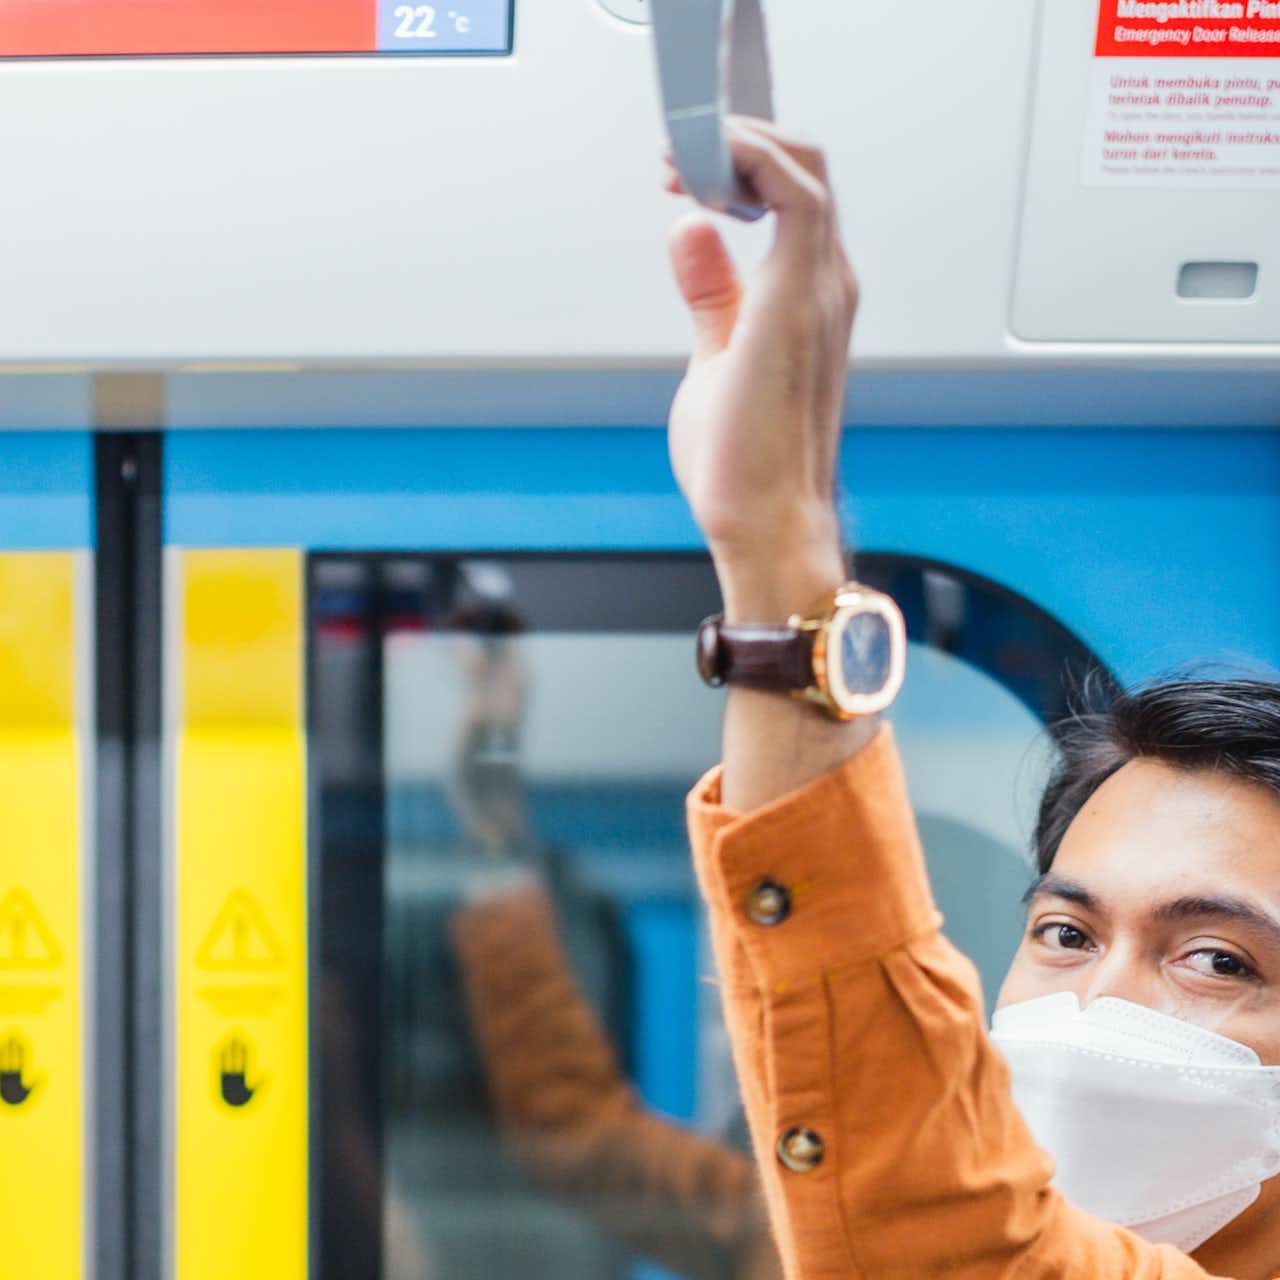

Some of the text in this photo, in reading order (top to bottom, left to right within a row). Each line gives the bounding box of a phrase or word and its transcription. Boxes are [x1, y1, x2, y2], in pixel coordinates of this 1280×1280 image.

[393, 5, 437, 38] 22
[1117, 0, 1244, 23] Mengaktifkan
[1114, 25, 1191, 46] Emergency
[1192, 26, 1227, 43] Door
